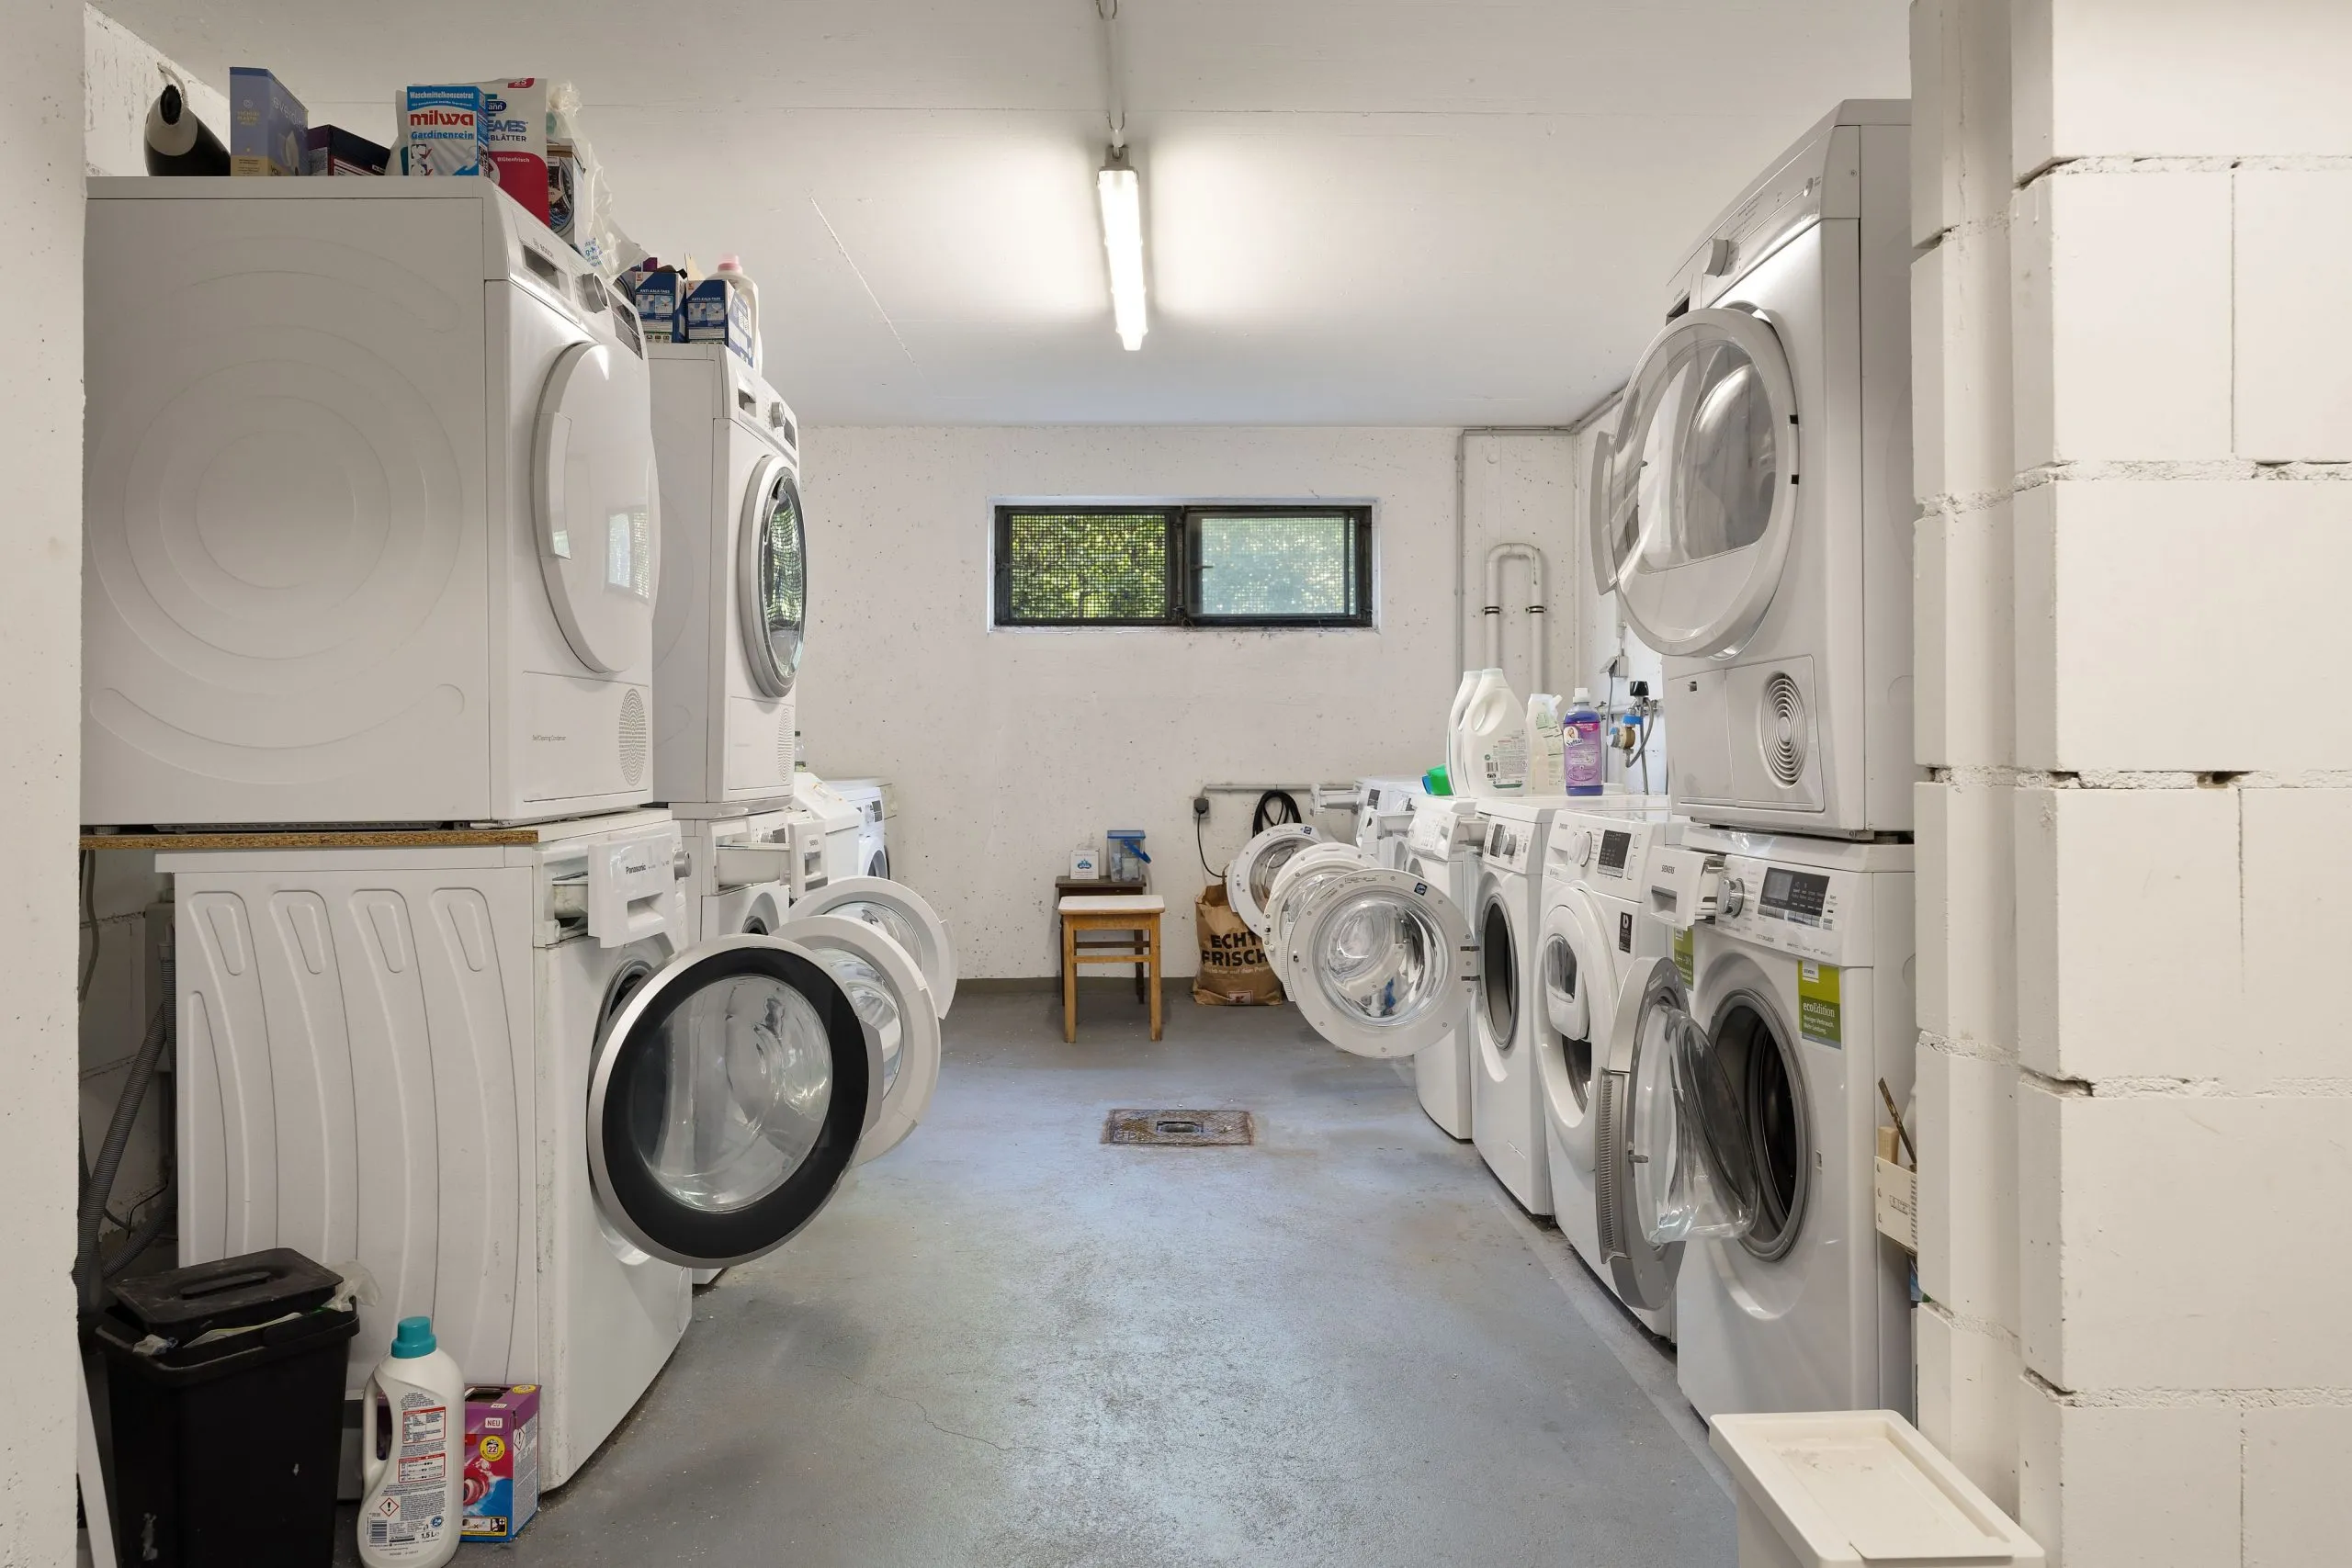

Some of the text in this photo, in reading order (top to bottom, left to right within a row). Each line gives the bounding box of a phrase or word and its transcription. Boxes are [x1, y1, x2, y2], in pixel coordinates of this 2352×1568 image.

[410, 110, 474, 126] milwa
[411, 130, 474, 141] Gardinenrein
[625, 863, 647, 874] Panasonic
[1661, 864, 1675, 874] SIEMENS
[1211, 931, 1257, 949] ECHT
[1202, 949, 1268, 967] FRISCH
[1803, 1002, 1836, 1018] ecoEdition
[421, 1531, 430, 1540] 1,5
